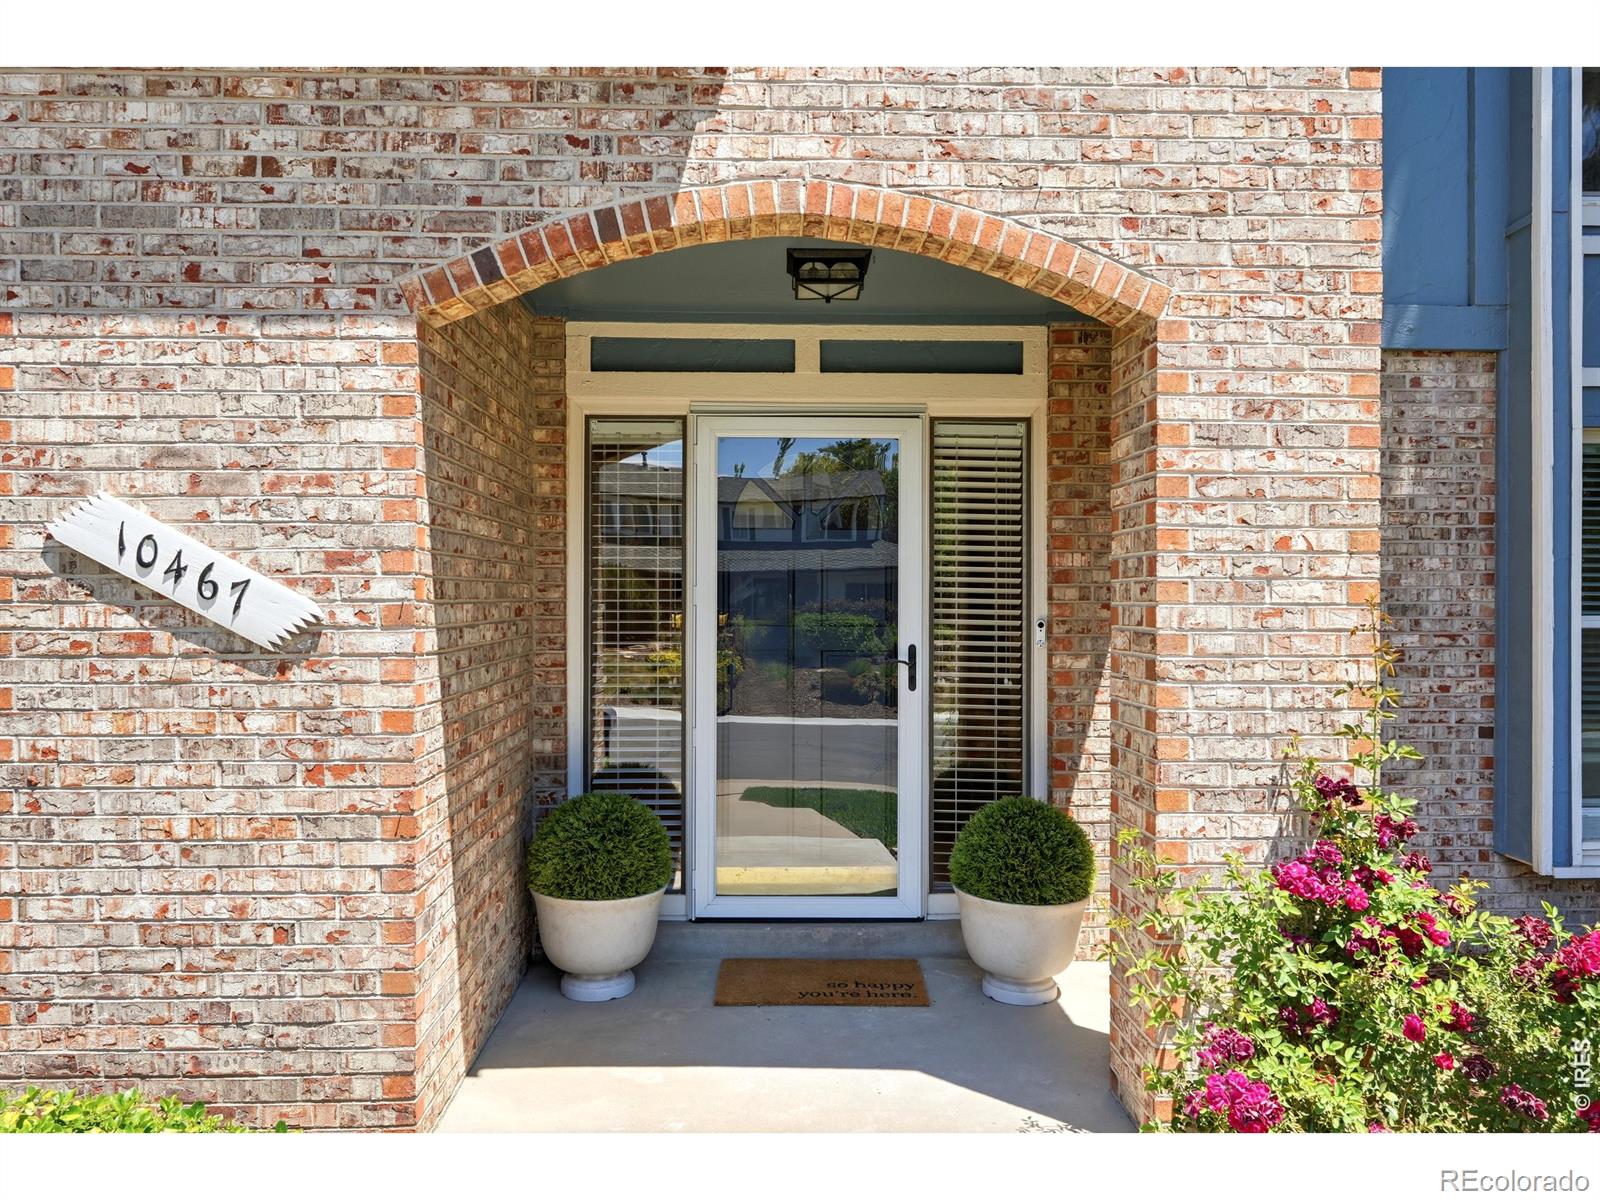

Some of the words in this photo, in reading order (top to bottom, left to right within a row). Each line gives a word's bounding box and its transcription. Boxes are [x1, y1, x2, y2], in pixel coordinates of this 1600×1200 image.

[118, 521, 251, 615] 10467
[854, 980, 915, 991] happy
[798, 990, 860, 999] you're
[865, 990, 918, 998] here.
